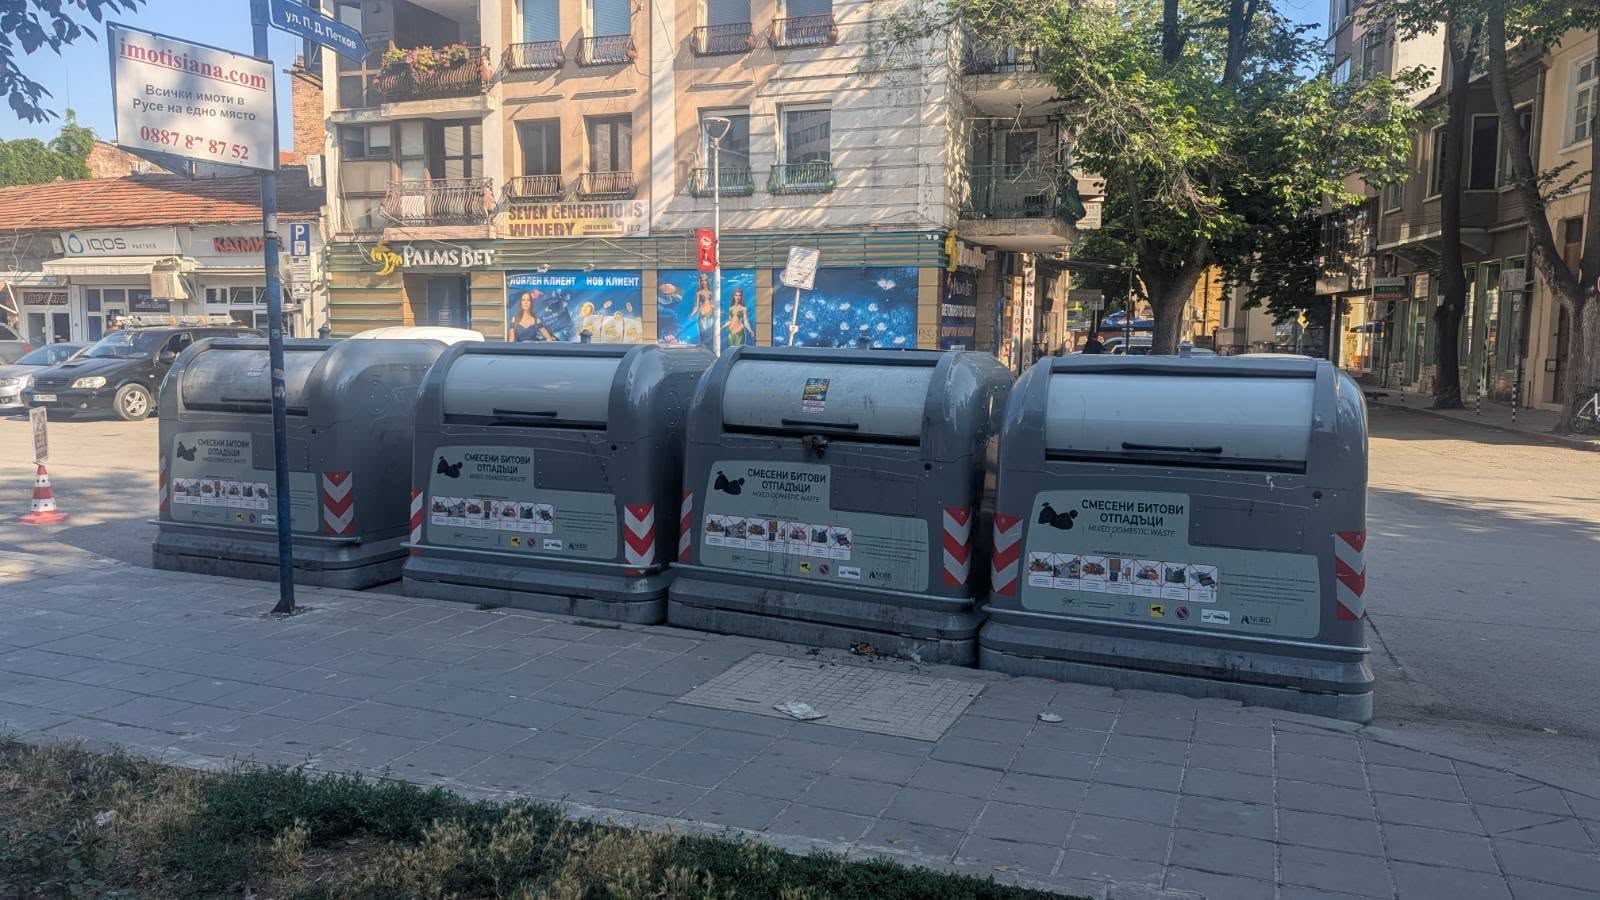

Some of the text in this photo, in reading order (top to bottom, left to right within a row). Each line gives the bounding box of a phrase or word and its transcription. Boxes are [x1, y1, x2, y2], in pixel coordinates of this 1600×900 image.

[285, 10, 357, 49] ул. П. Д. Петков
[120, 37, 267, 90] imotisiana.com
[145, 84, 245, 105] Всички имоти в
[132, 98, 256, 121] Русе на едно място
[140, 125, 180, 147] 0887
[208, 139, 227, 156] 87
[231, 144, 249, 160] 52
[508, 202, 643, 220] SEVEN GENERATIONS
[295, 225, 305, 240] P
[508, 222, 575, 236] WINERY
[87, 238, 126, 252] IQOS
[509, 276, 640, 287] ЛОЯЛЕН КЛИЕНТ НОВ КЛИЕНТ
[464, 453, 530, 465] СМЕСЕНИ БИТОВИ
[476, 463, 518, 474] ОТПАДЪЦИ
[747, 468, 826, 483] СМЕСЕНИ БИТОВИ
[761, 480, 811, 493] ОТПАДЪЦИ
[1081, 499, 1184, 515] СМЕСЕНИ БИТОВИ
[1100, 512, 1164, 527] ОТПАДЪЦИ
[1088, 524, 1177, 538] MIXED DOMESTIC WASTE
[1249, 615, 1271, 624] NORD
